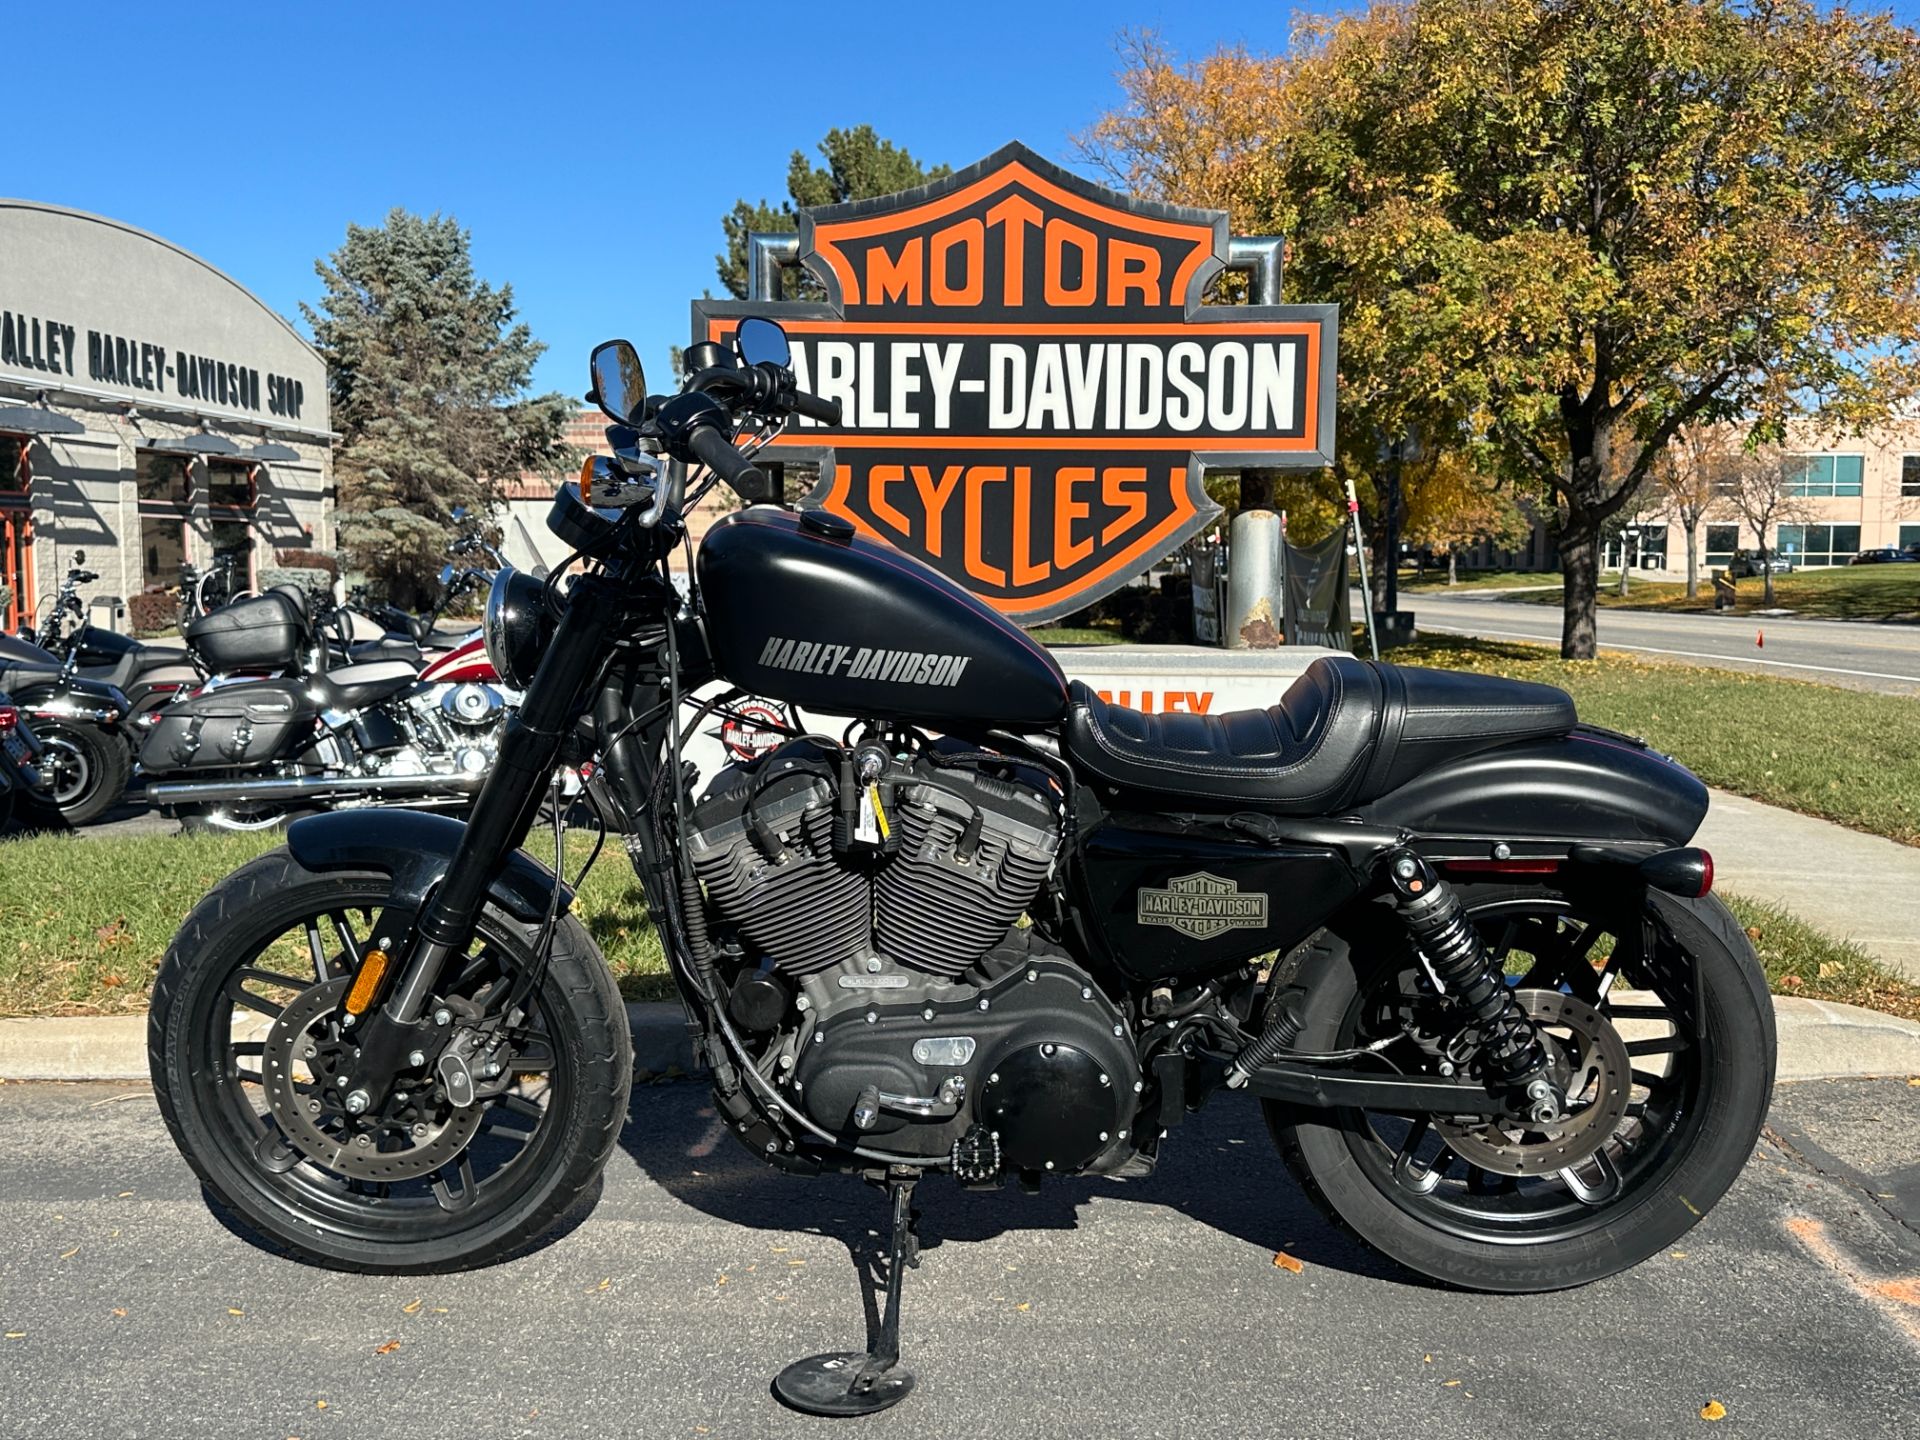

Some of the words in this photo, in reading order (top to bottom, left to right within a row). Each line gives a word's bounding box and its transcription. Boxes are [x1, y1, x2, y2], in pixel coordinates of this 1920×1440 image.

[866, 193, 1162, 307] MOTOR
[0, 310, 75, 377] ALLEY
[87, 330, 261, 412] HARLEY-DAVIDSON
[267, 373, 304, 420] SHOP
[732, 340, 1296, 432] ARLEY-DAVIDSON
[868, 465, 1147, 588] CYCLES
[758, 636, 969, 687] HARLEY-DAVIDSON
[1144, 895, 1260, 916] HARLEY-DAVIDSON
[1176, 878, 1228, 895] MOTOR
[1177, 918, 1226, 936] CYCLES
